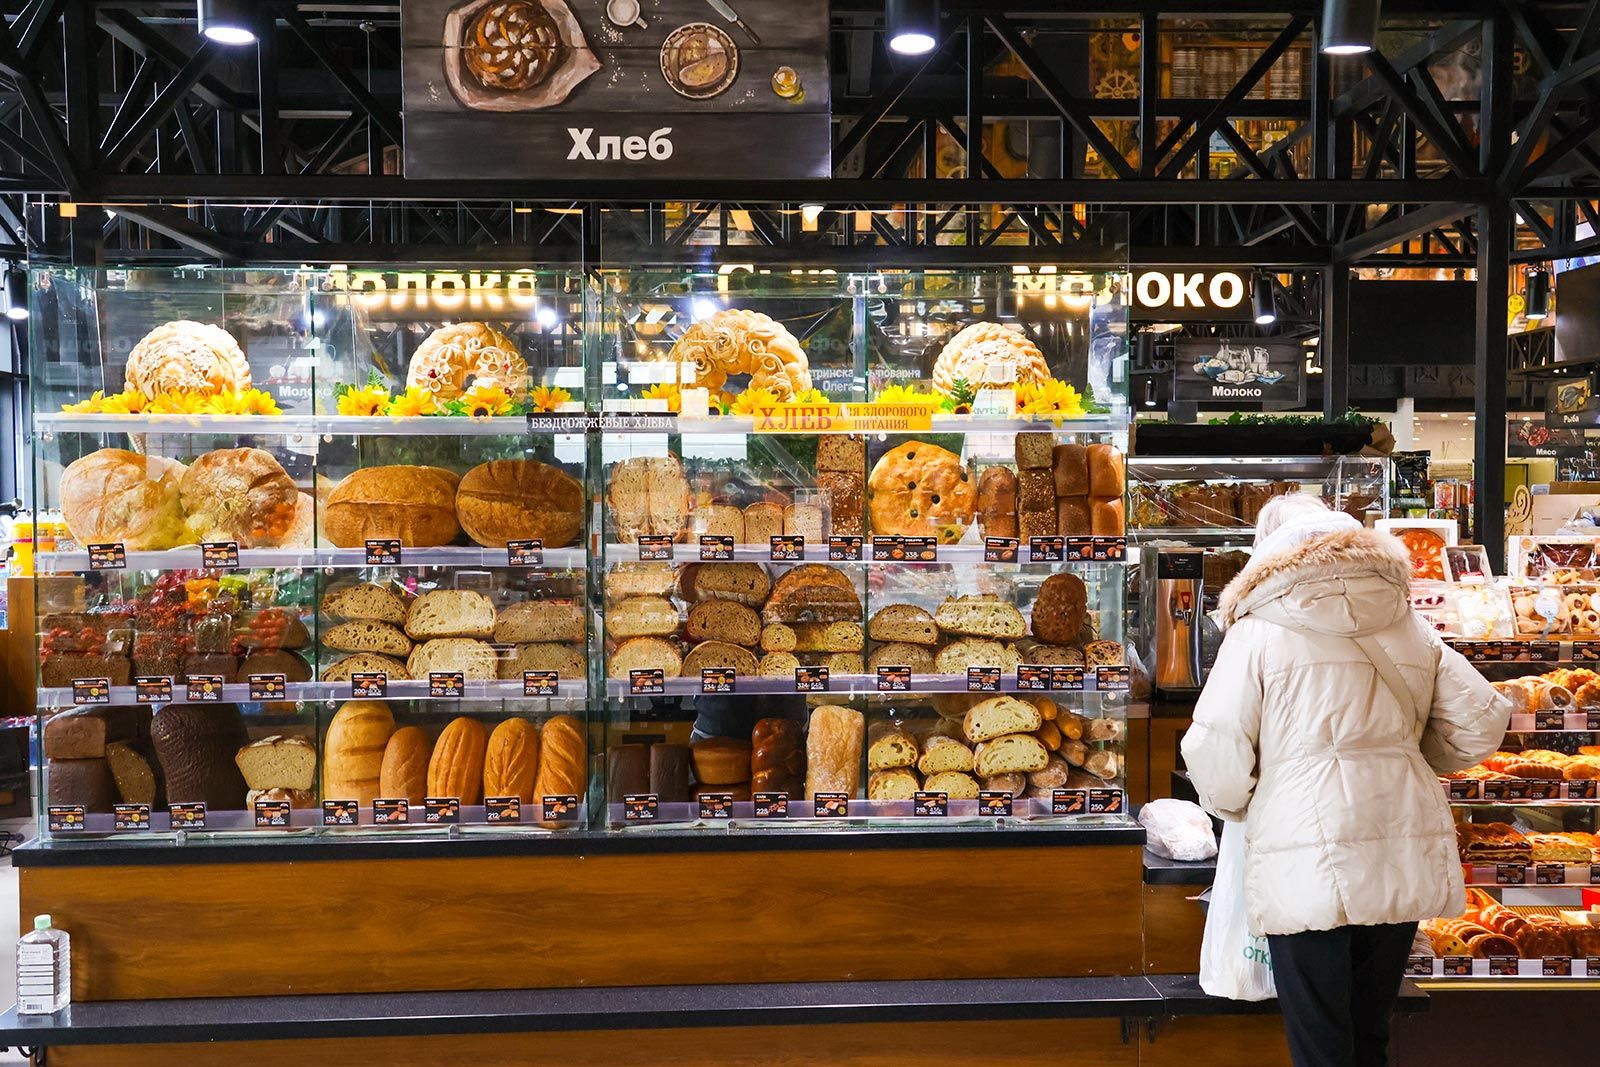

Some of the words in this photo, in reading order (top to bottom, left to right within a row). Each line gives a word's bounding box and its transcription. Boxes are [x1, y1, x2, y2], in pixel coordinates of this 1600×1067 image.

[567, 127, 673, 160] Хлеб
[1012, 265, 1244, 308] Молоко
[1212, 386, 1262, 397] Молоко
[759, 407, 832, 430] ХЛЕБ
[863, 407, 927, 419] ЗДОРОВОГО
[634, 417, 673, 429] ХЛЕБА
[854, 419, 909, 430] ПИТАНИЯ
[1536, 448, 1557, 456] Мясо
